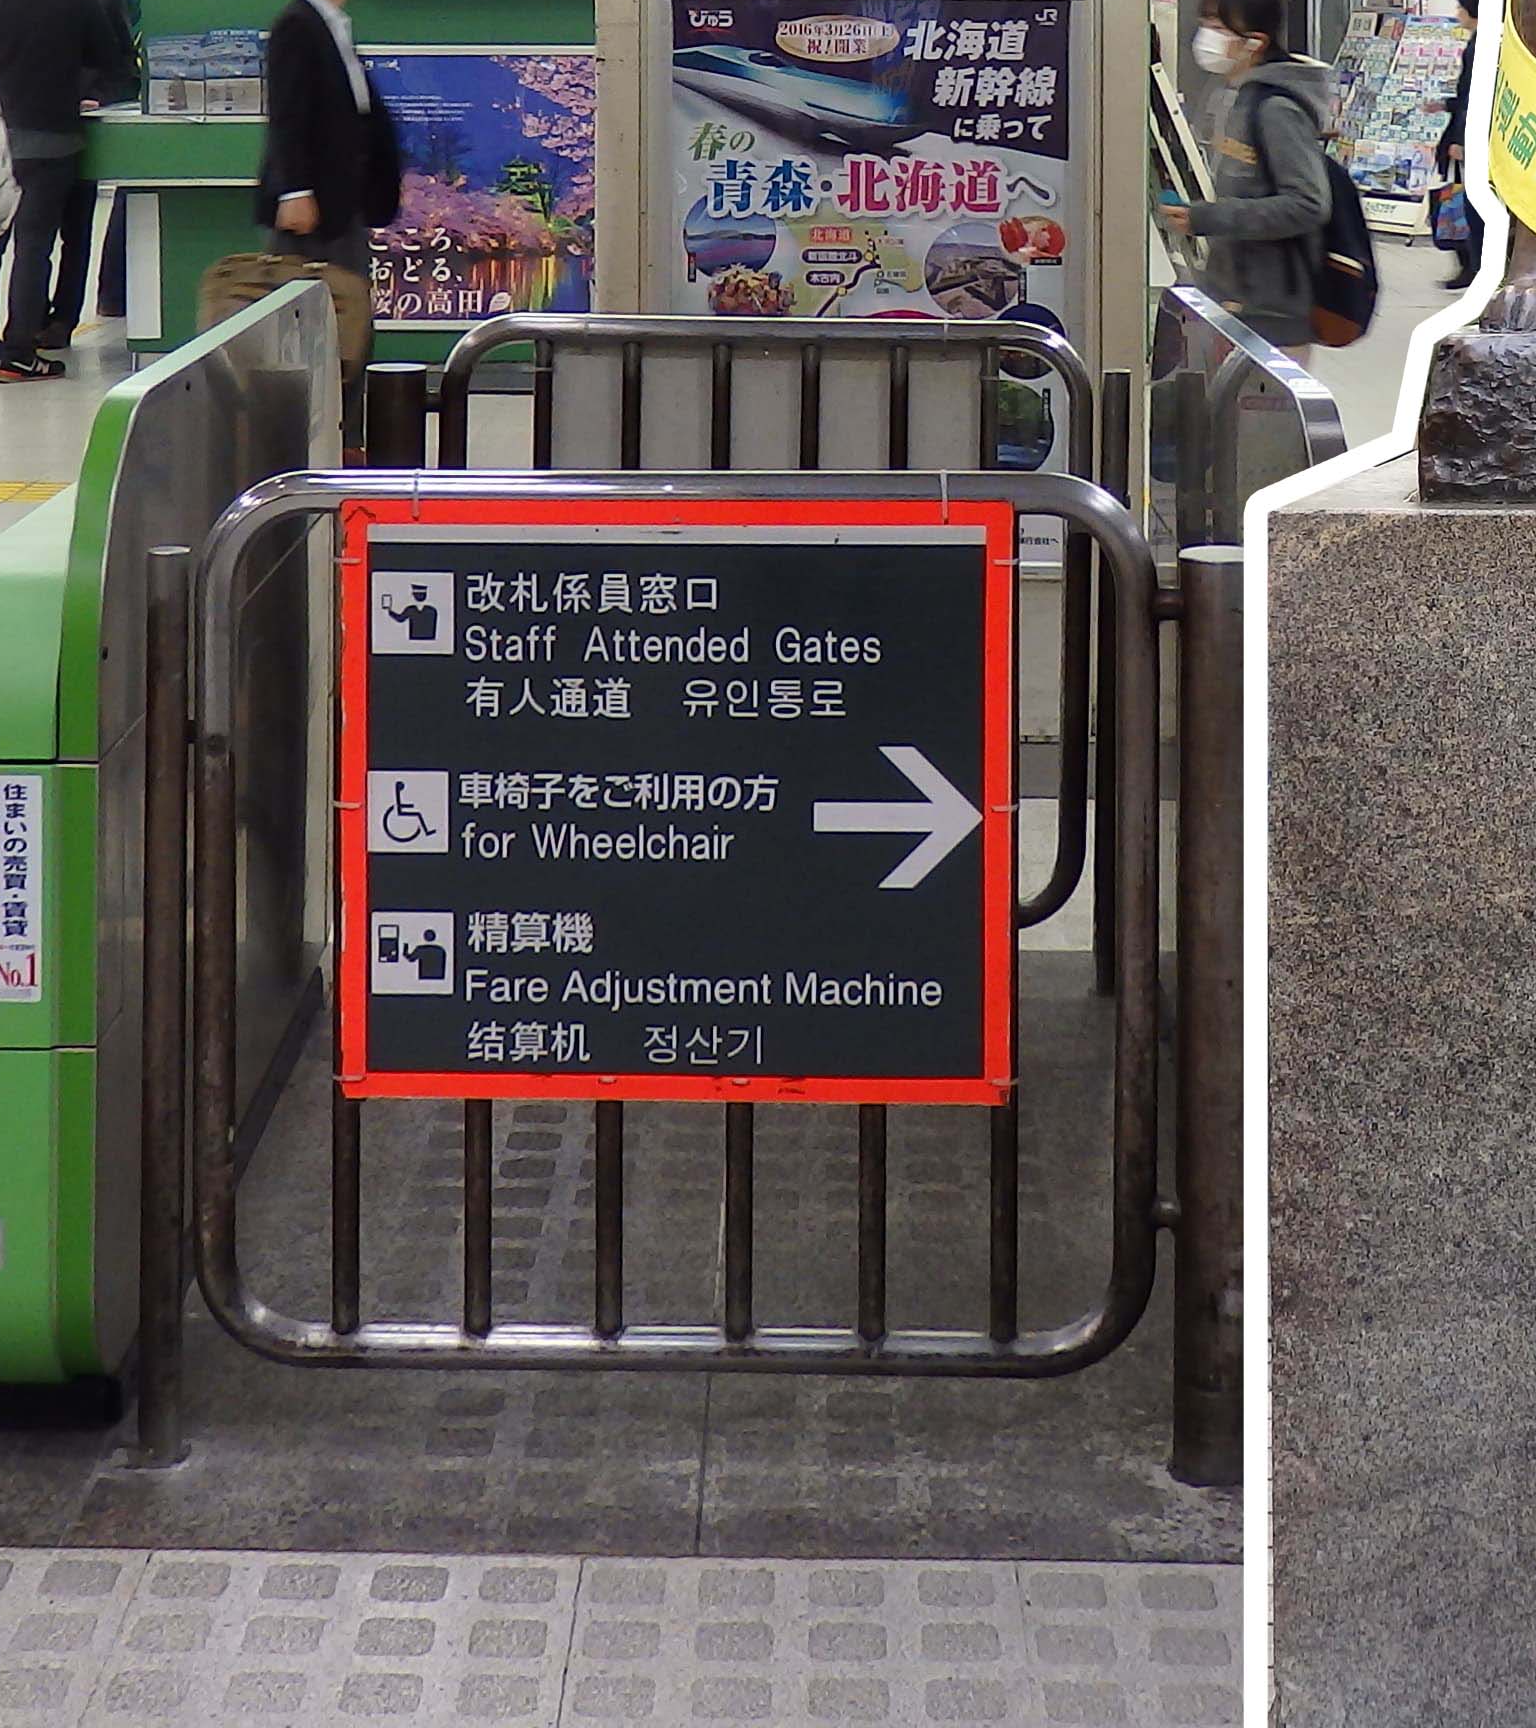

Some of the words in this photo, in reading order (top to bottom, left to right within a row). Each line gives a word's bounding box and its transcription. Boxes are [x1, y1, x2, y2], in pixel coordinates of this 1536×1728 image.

[902, 21, 1030, 61] 北海道
[931, 67, 1058, 108] 新幹線
[687, 122, 756, 161] 春の
[952, 113, 1053, 141] に乗って
[707, 159, 1052, 214] 青森・北海道へ
[465, 573, 719, 613] 改札係員窓口
[464, 626, 555, 662] Staff
[583, 626, 750, 663] Attended
[775, 628, 881, 663] Gates
[465, 677, 631, 718] 有人通道
[683, 679, 847, 719] 유인통로
[459, 773, 779, 812] 車椅子をご利用の方
[461, 824, 516, 859] for
[532, 823, 735, 861] Wheelchair
[467, 913, 594, 954] 精算機
[465, 970, 548, 1003] Fare
[562, 970, 771, 1011] Adjustment
[785, 972, 943, 1007] Machine
[467, 1022, 591, 1062] 结算机
[643, 1025, 762, 1064] 정산기
